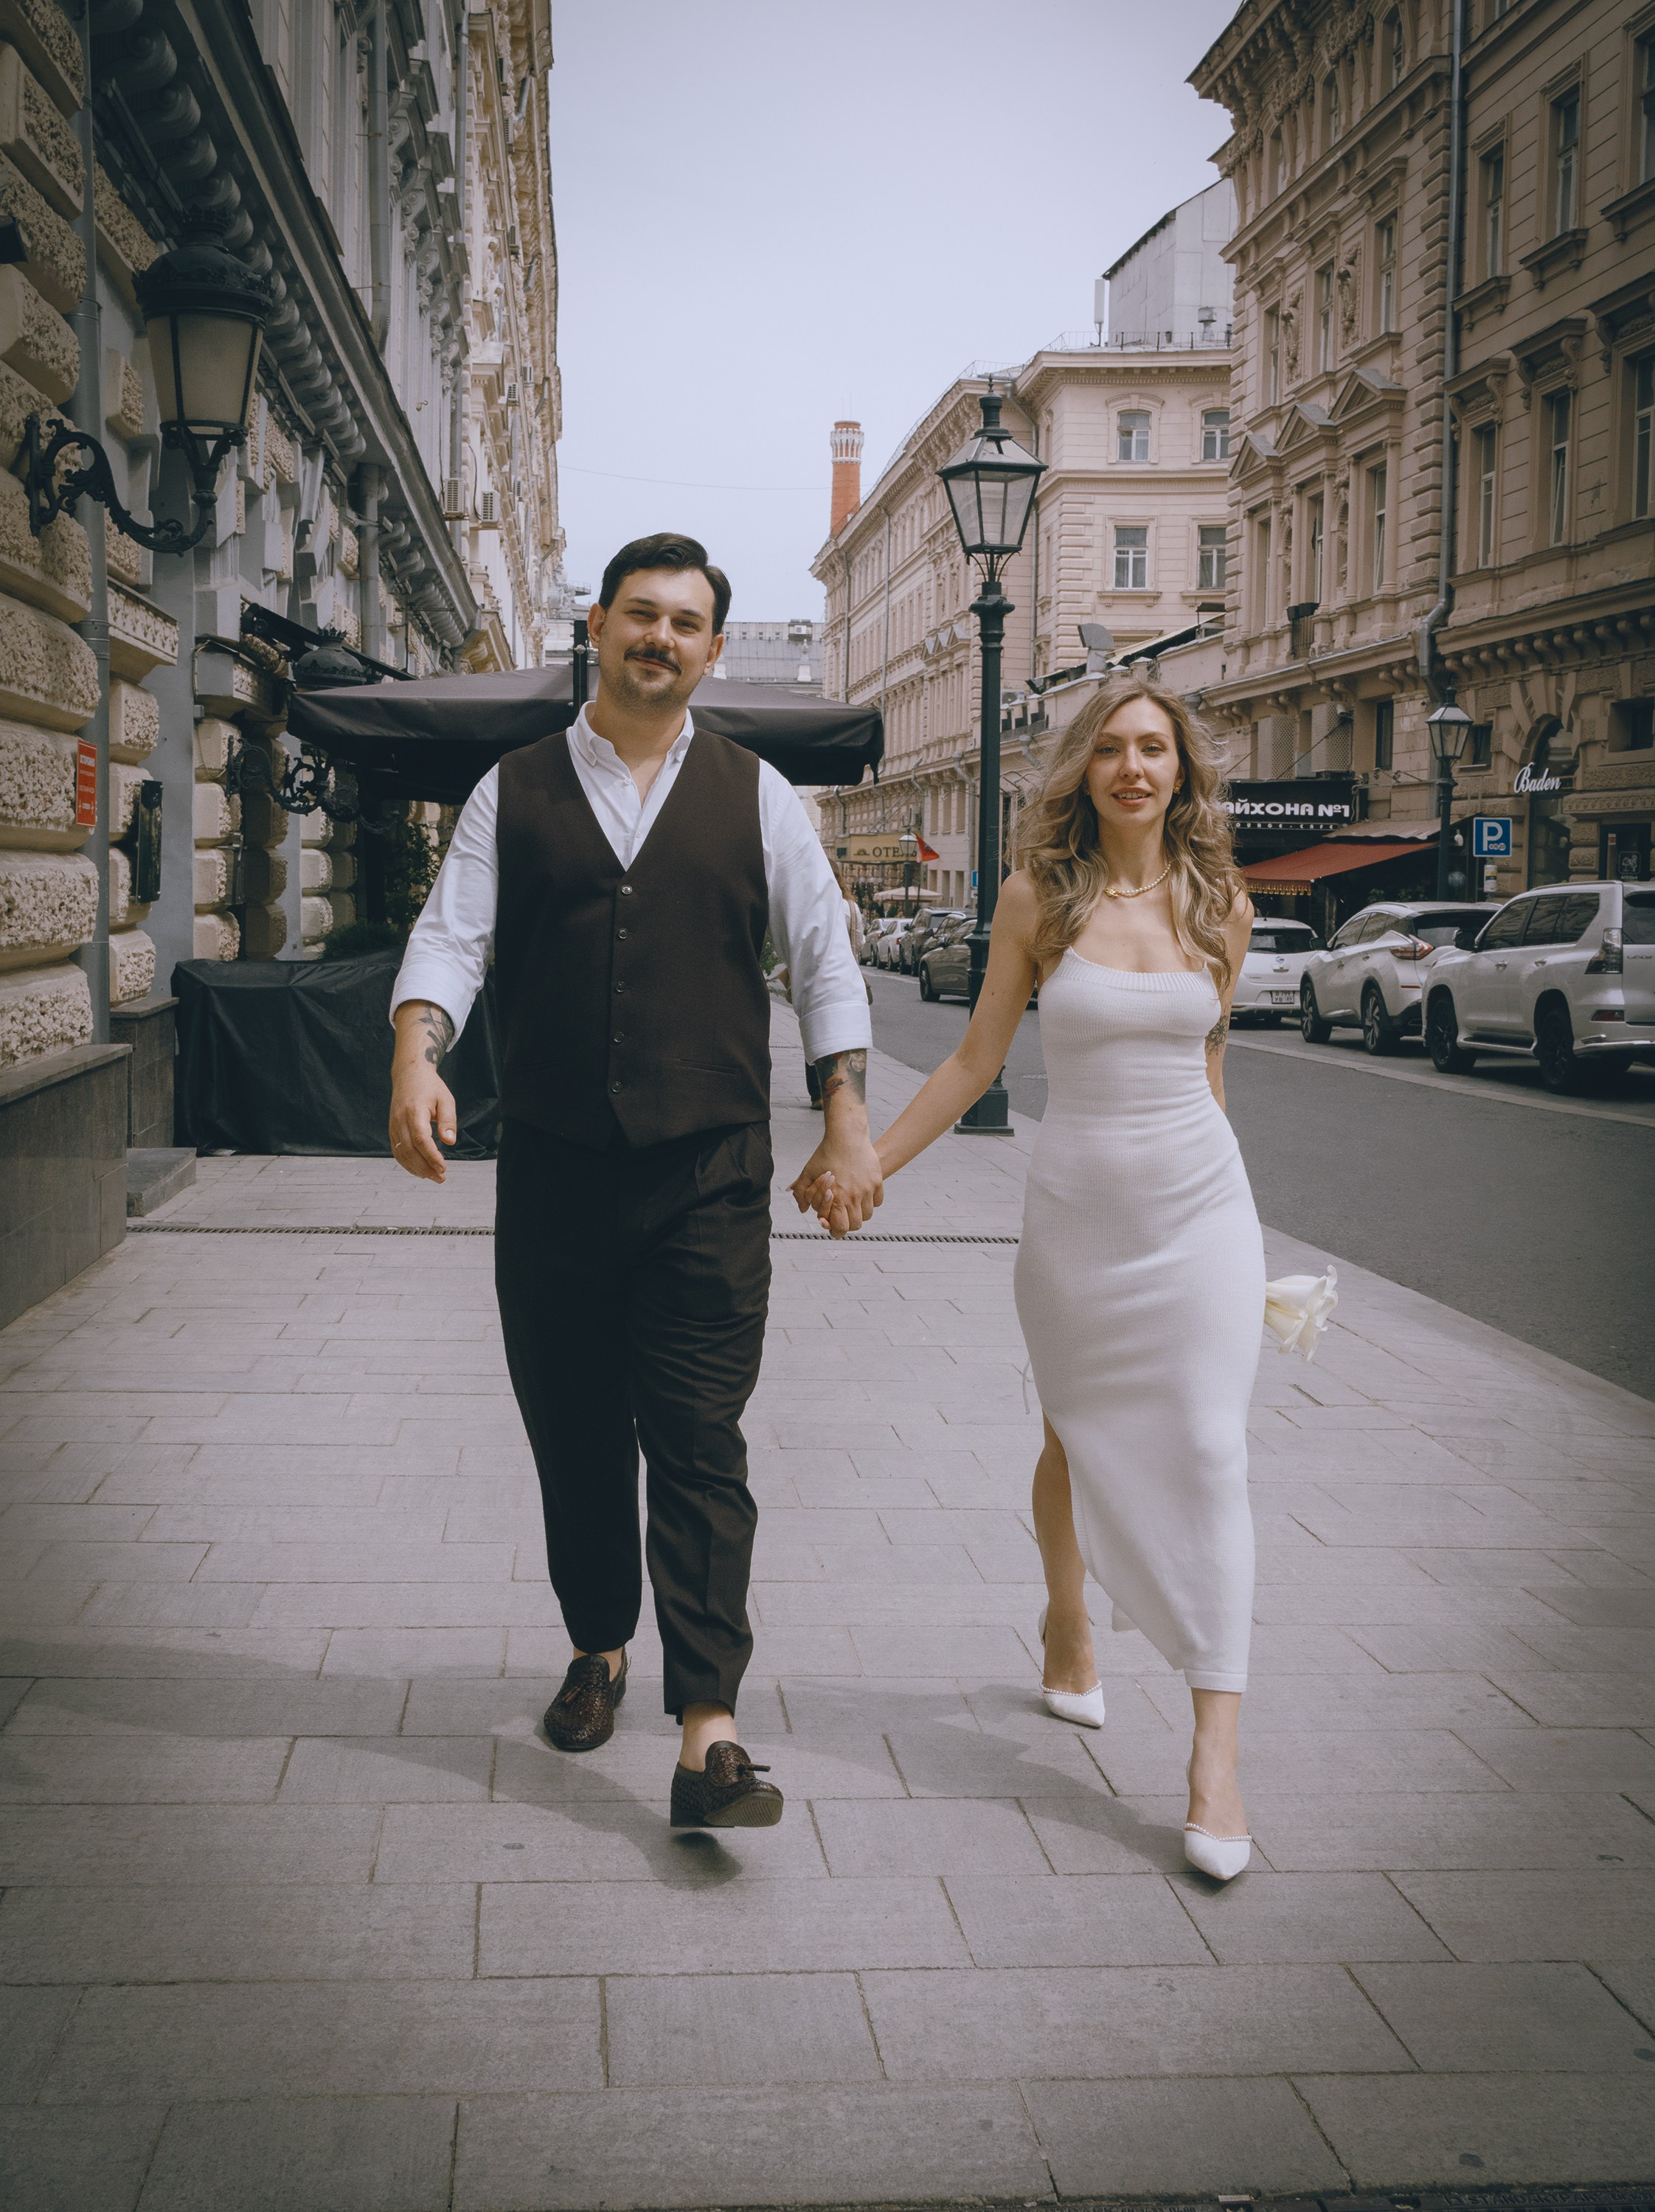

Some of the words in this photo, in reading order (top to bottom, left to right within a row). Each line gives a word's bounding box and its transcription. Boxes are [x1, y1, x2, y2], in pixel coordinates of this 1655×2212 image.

[1514, 762, 1561, 793] Baden
[1214, 798, 1314, 815] АЙХОНА
[1318, 804, 1350, 817] №1
[1482, 821, 1503, 852] P
